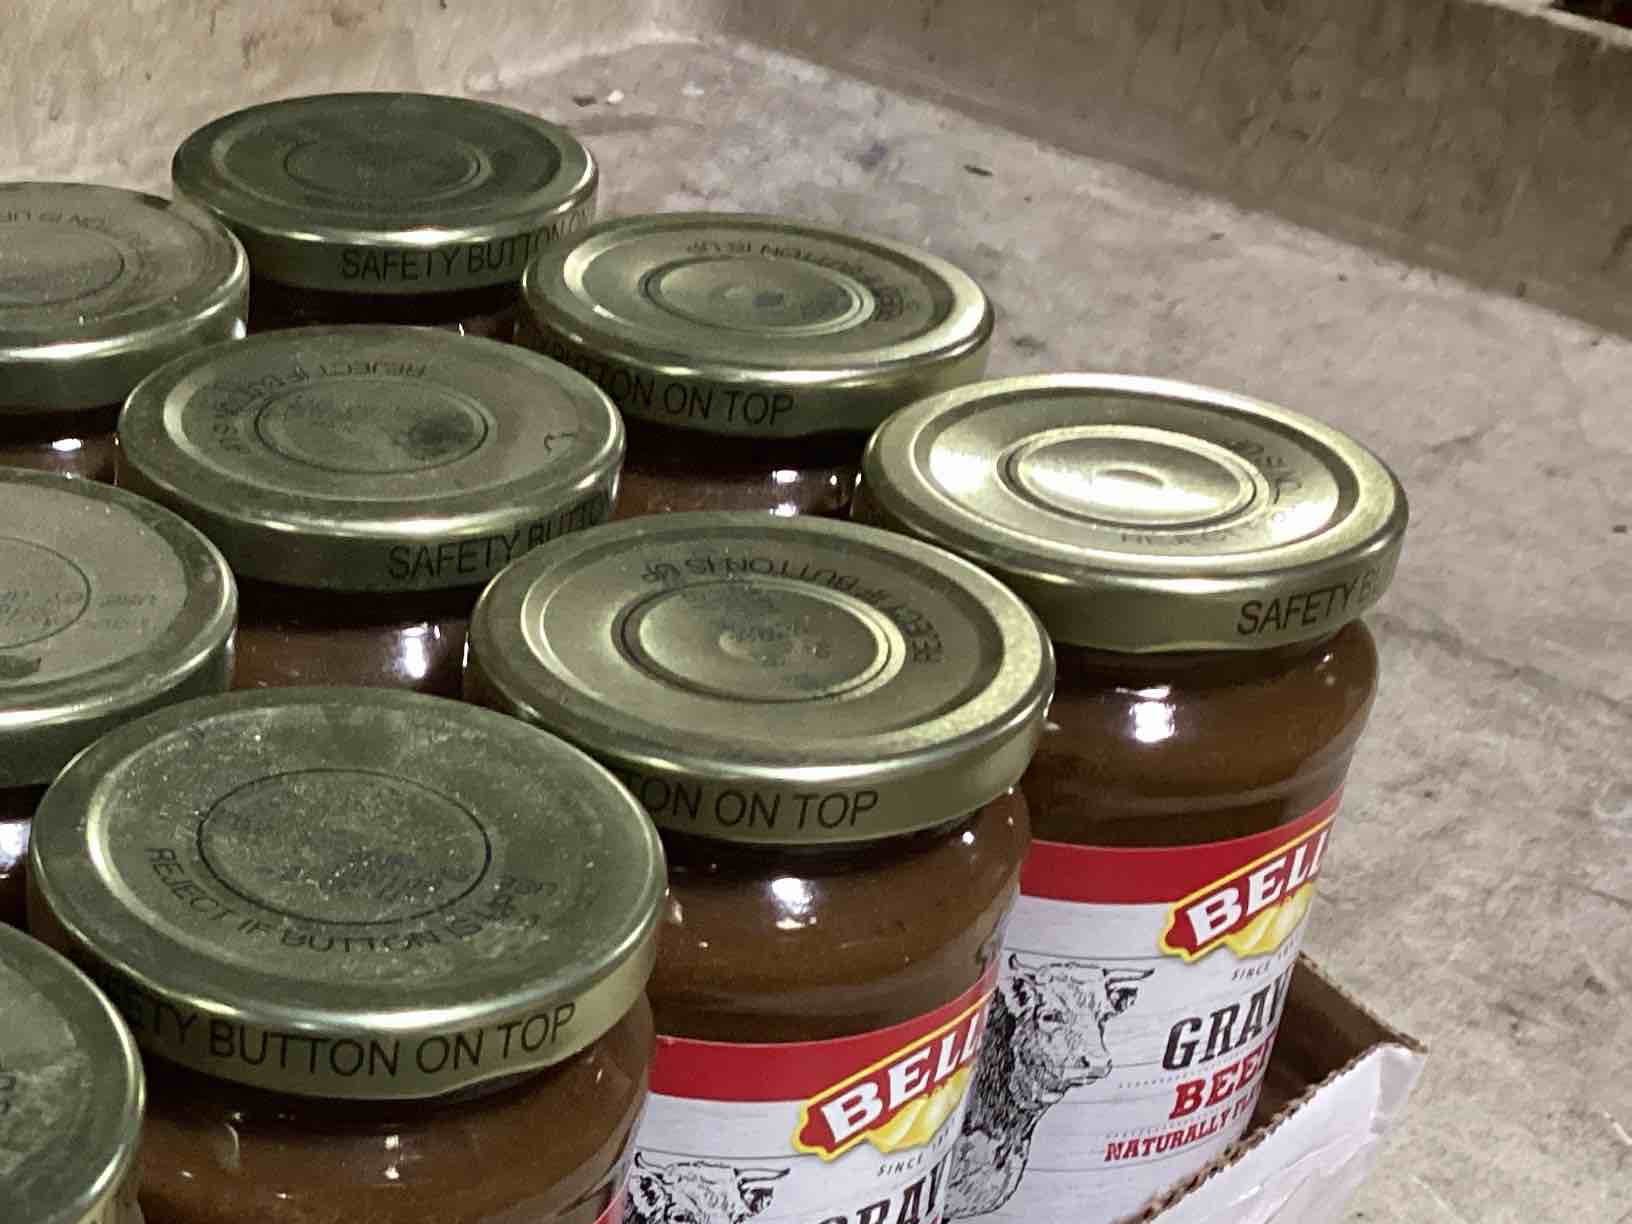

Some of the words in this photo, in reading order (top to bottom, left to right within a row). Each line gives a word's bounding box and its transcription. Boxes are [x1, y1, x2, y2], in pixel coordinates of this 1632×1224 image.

[340, 247, 460, 282] SAFETY
[664, 383, 712, 420] ON
[724, 389, 795, 425] TOP
[389, 532, 520, 580] SAFETY
[1237, 576, 1360, 636] SAFETY
[714, 790, 780, 829] ON
[793, 790, 878, 829] TOP
[208, 1019, 400, 1077] BUTTON
[416, 1028, 484, 1074] ON
[496, 1002, 576, 1060] TOP
[1162, 961, 1297, 1071] GRAV
[1104, 1104, 1231, 1162] NATURALLY
